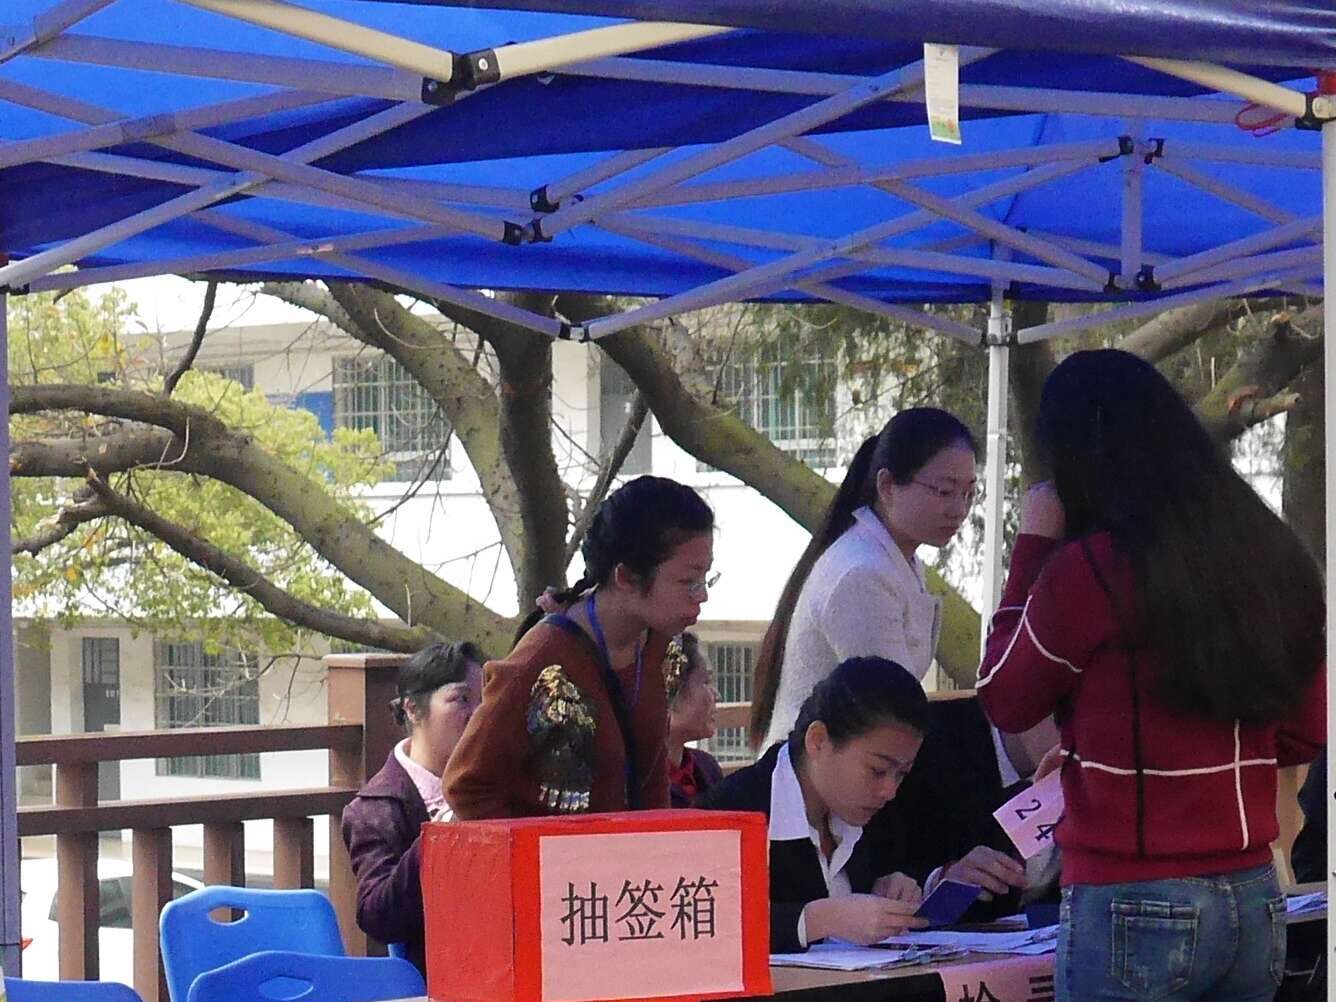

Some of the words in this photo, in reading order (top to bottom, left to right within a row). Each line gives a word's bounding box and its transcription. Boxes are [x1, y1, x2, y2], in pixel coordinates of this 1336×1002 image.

[1015, 799, 1059, 841] 24
[560, 876, 719, 946] 抽签箱
